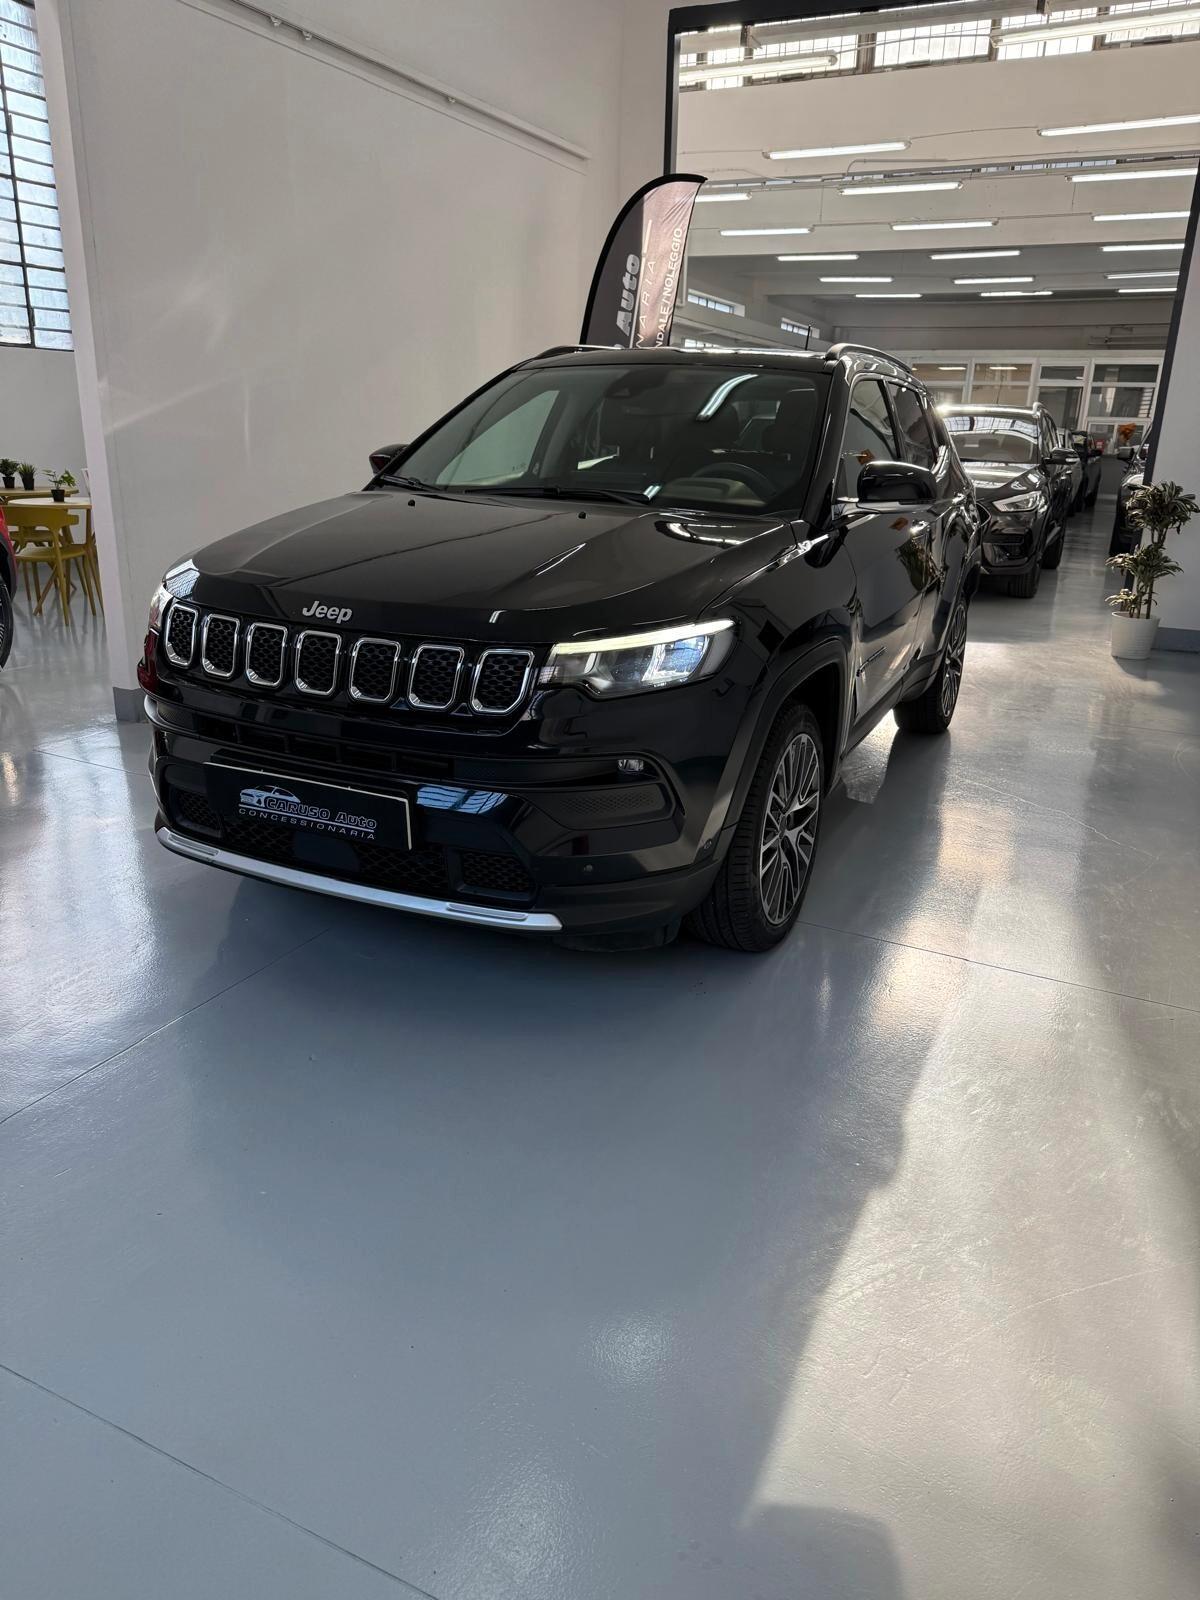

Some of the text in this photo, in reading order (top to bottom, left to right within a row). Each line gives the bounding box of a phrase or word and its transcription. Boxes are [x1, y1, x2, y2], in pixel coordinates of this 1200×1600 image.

[302, 600, 353, 624] Jeep
[265, 797, 331, 820] CARUSO
[238, 808, 376, 840] CONCESSIONARIA
